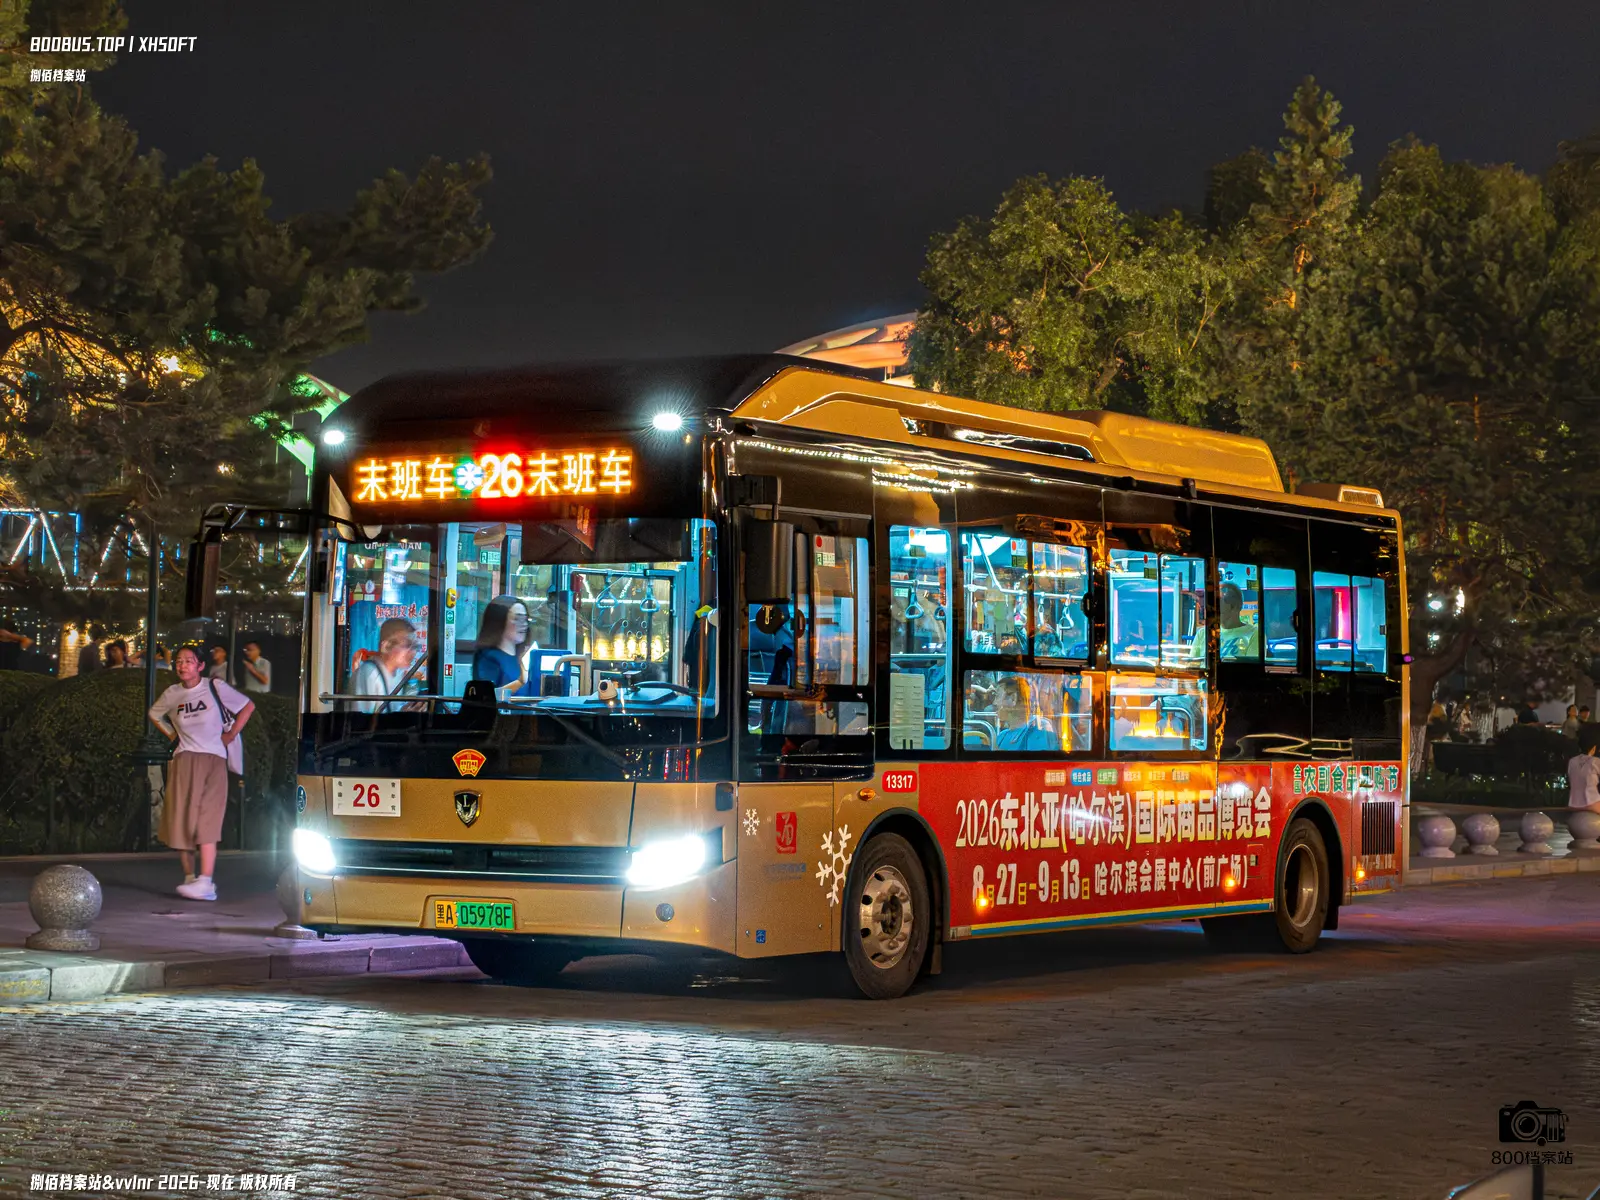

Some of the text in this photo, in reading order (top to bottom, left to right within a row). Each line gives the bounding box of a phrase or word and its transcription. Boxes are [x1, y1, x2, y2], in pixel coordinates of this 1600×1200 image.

[357, 449, 632, 501] 末班车 26 末班车
[177, 700, 208, 715] FILA
[885, 774, 913, 789] 13317
[352, 783, 381, 808] 26
